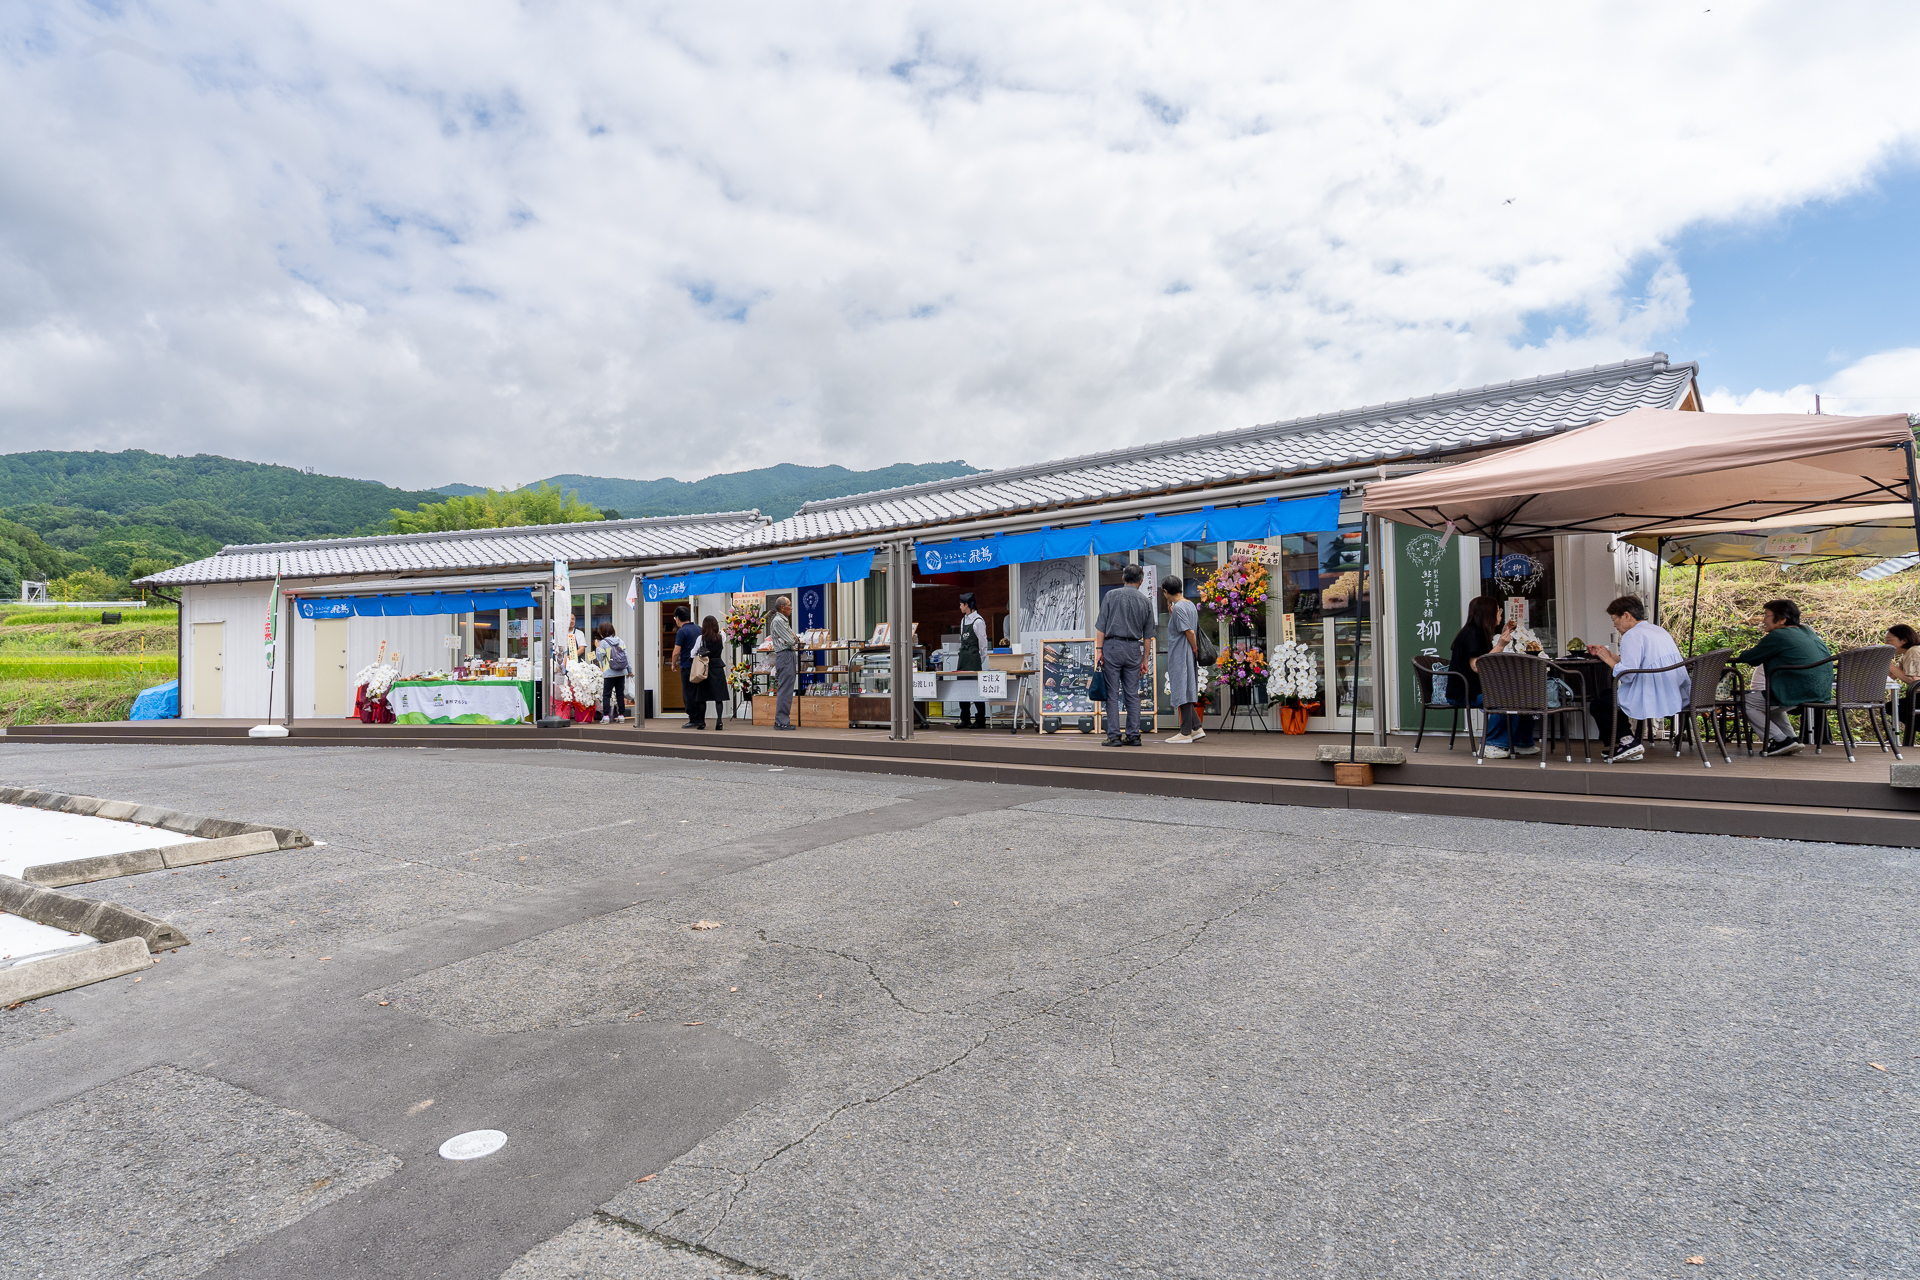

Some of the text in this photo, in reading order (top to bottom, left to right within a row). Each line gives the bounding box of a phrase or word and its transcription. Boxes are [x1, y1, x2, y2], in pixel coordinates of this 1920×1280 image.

[982, 674, 1000, 682] ご注文
[982, 685, 1000, 693] お会計
